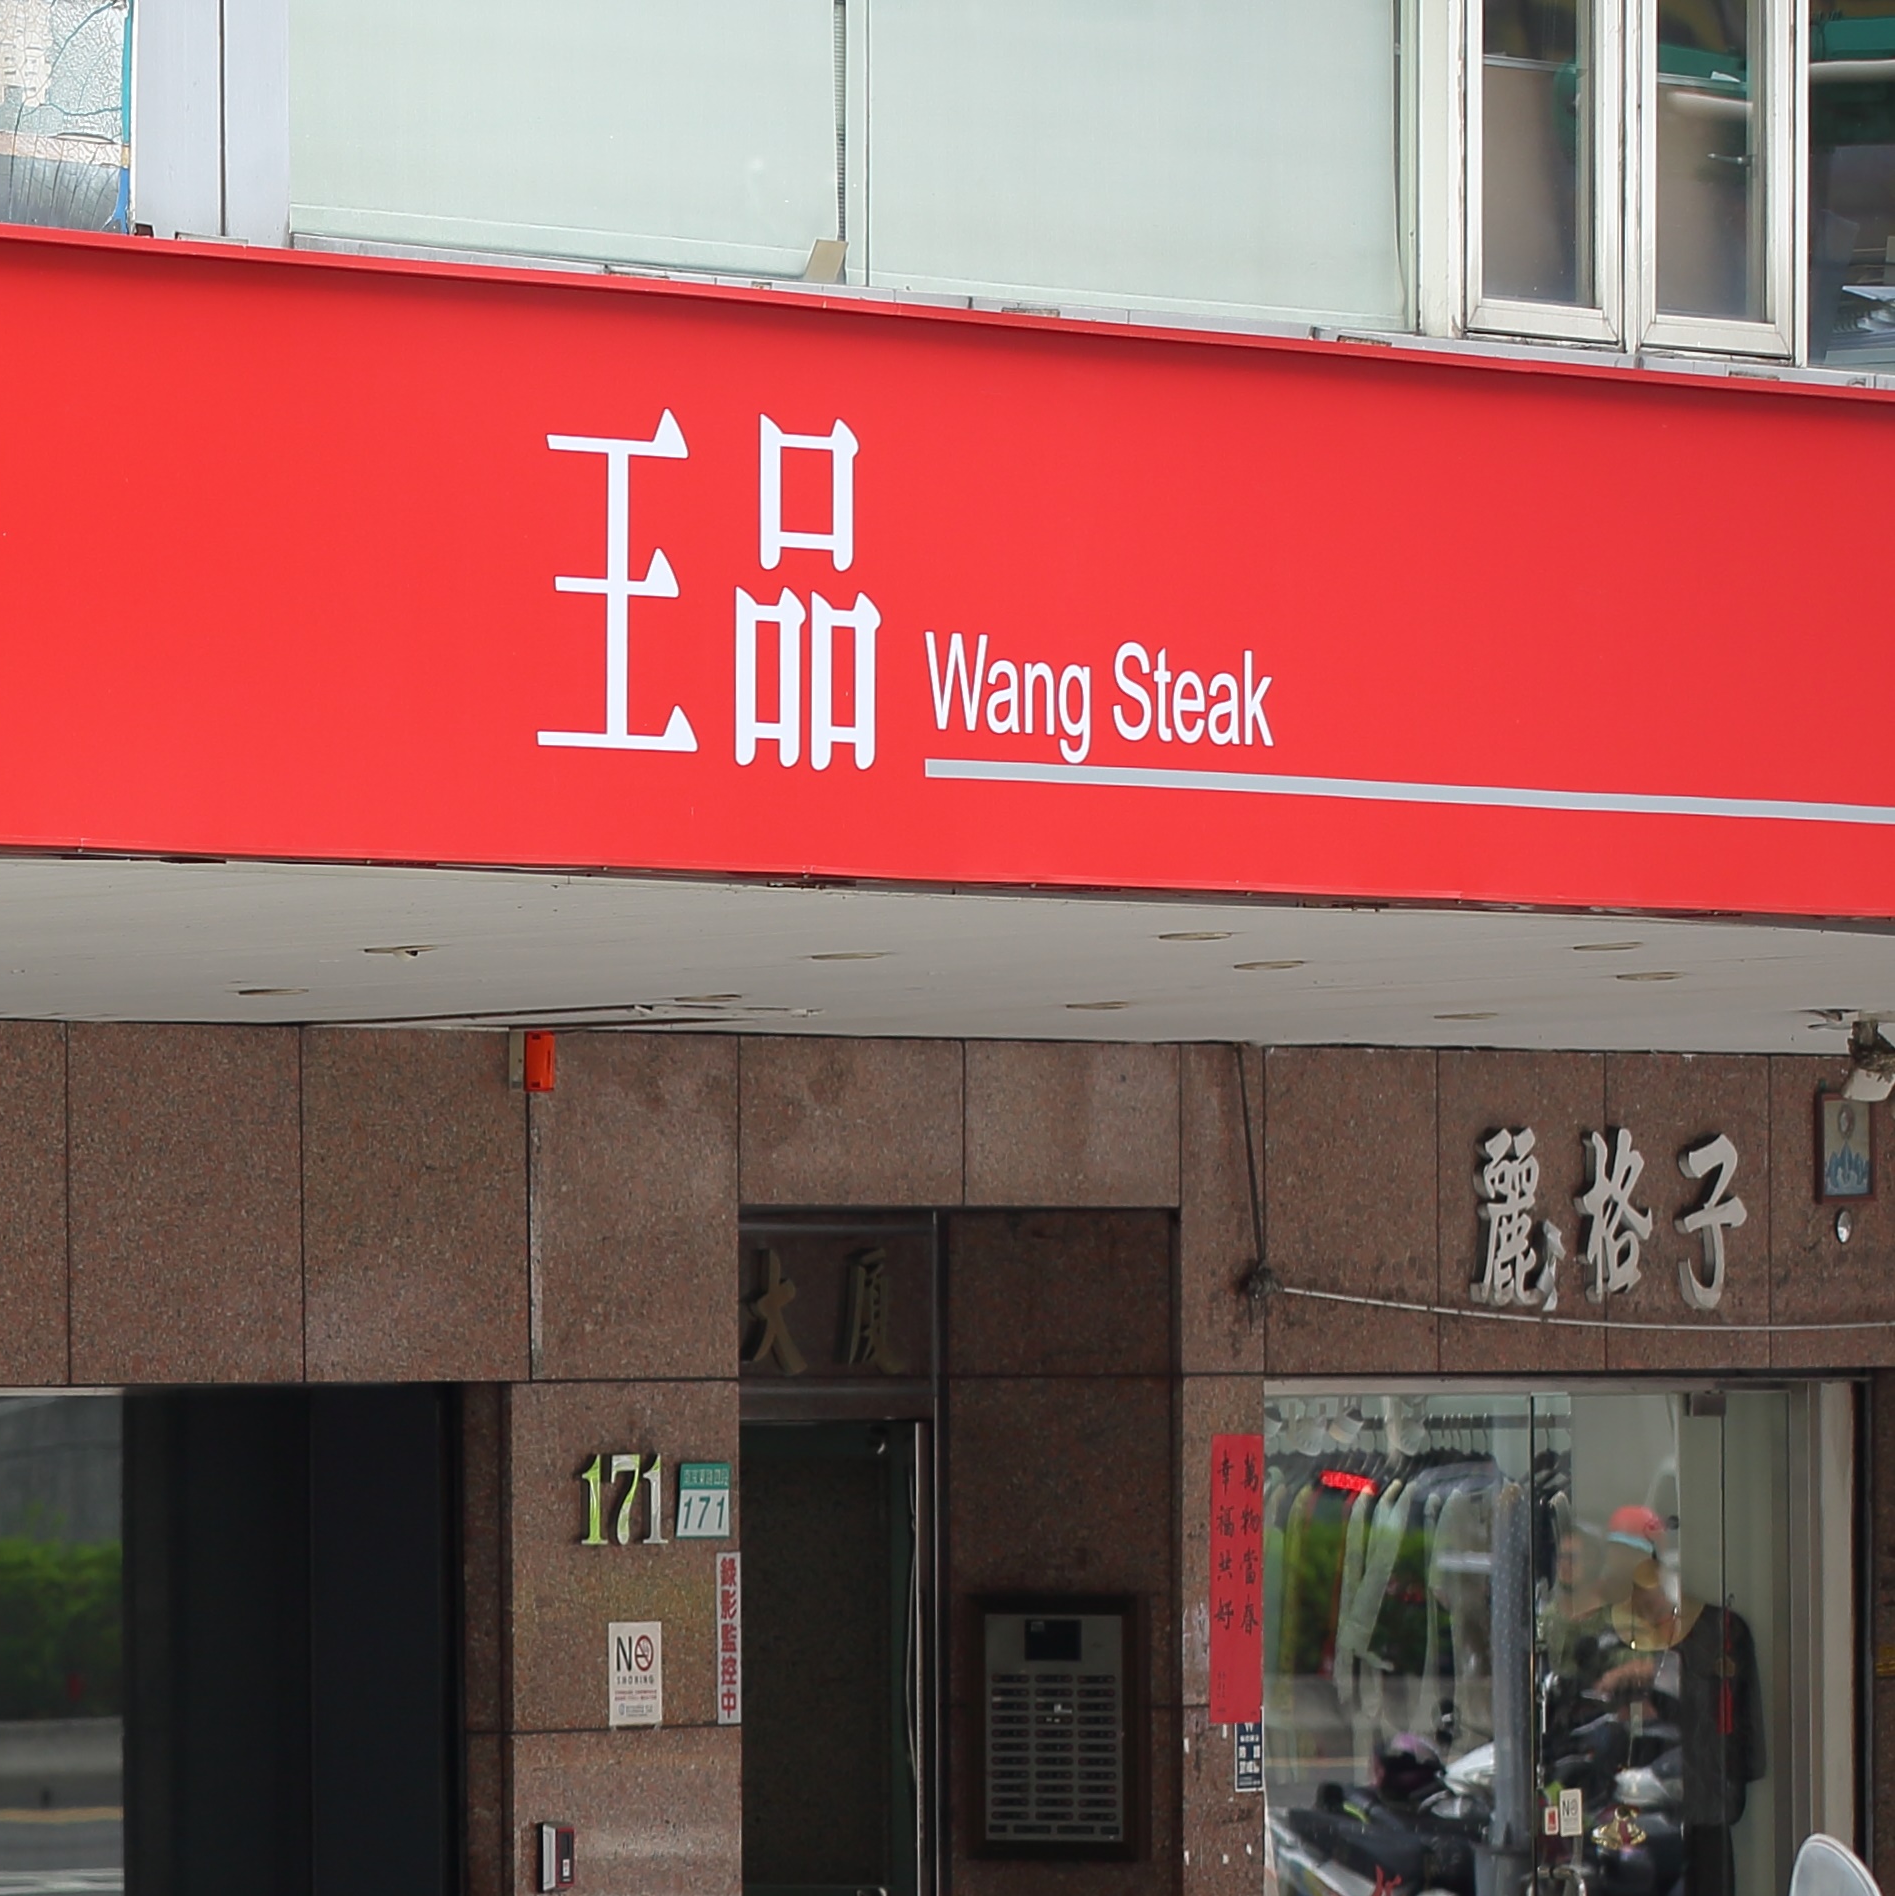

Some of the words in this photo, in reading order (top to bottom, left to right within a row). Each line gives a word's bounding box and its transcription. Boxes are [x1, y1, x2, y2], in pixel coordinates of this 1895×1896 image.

[536, 408, 882, 771] 王品
[924, 631, 1091, 764] Wang
[1112, 641, 1274, 747] Steak
[1471, 1127, 1748, 1312] 麗格子
[581, 1454, 670, 1545] 171
[684, 1495, 726, 1530] 171
[719, 1556, 738, 1720] 錄影監控中
